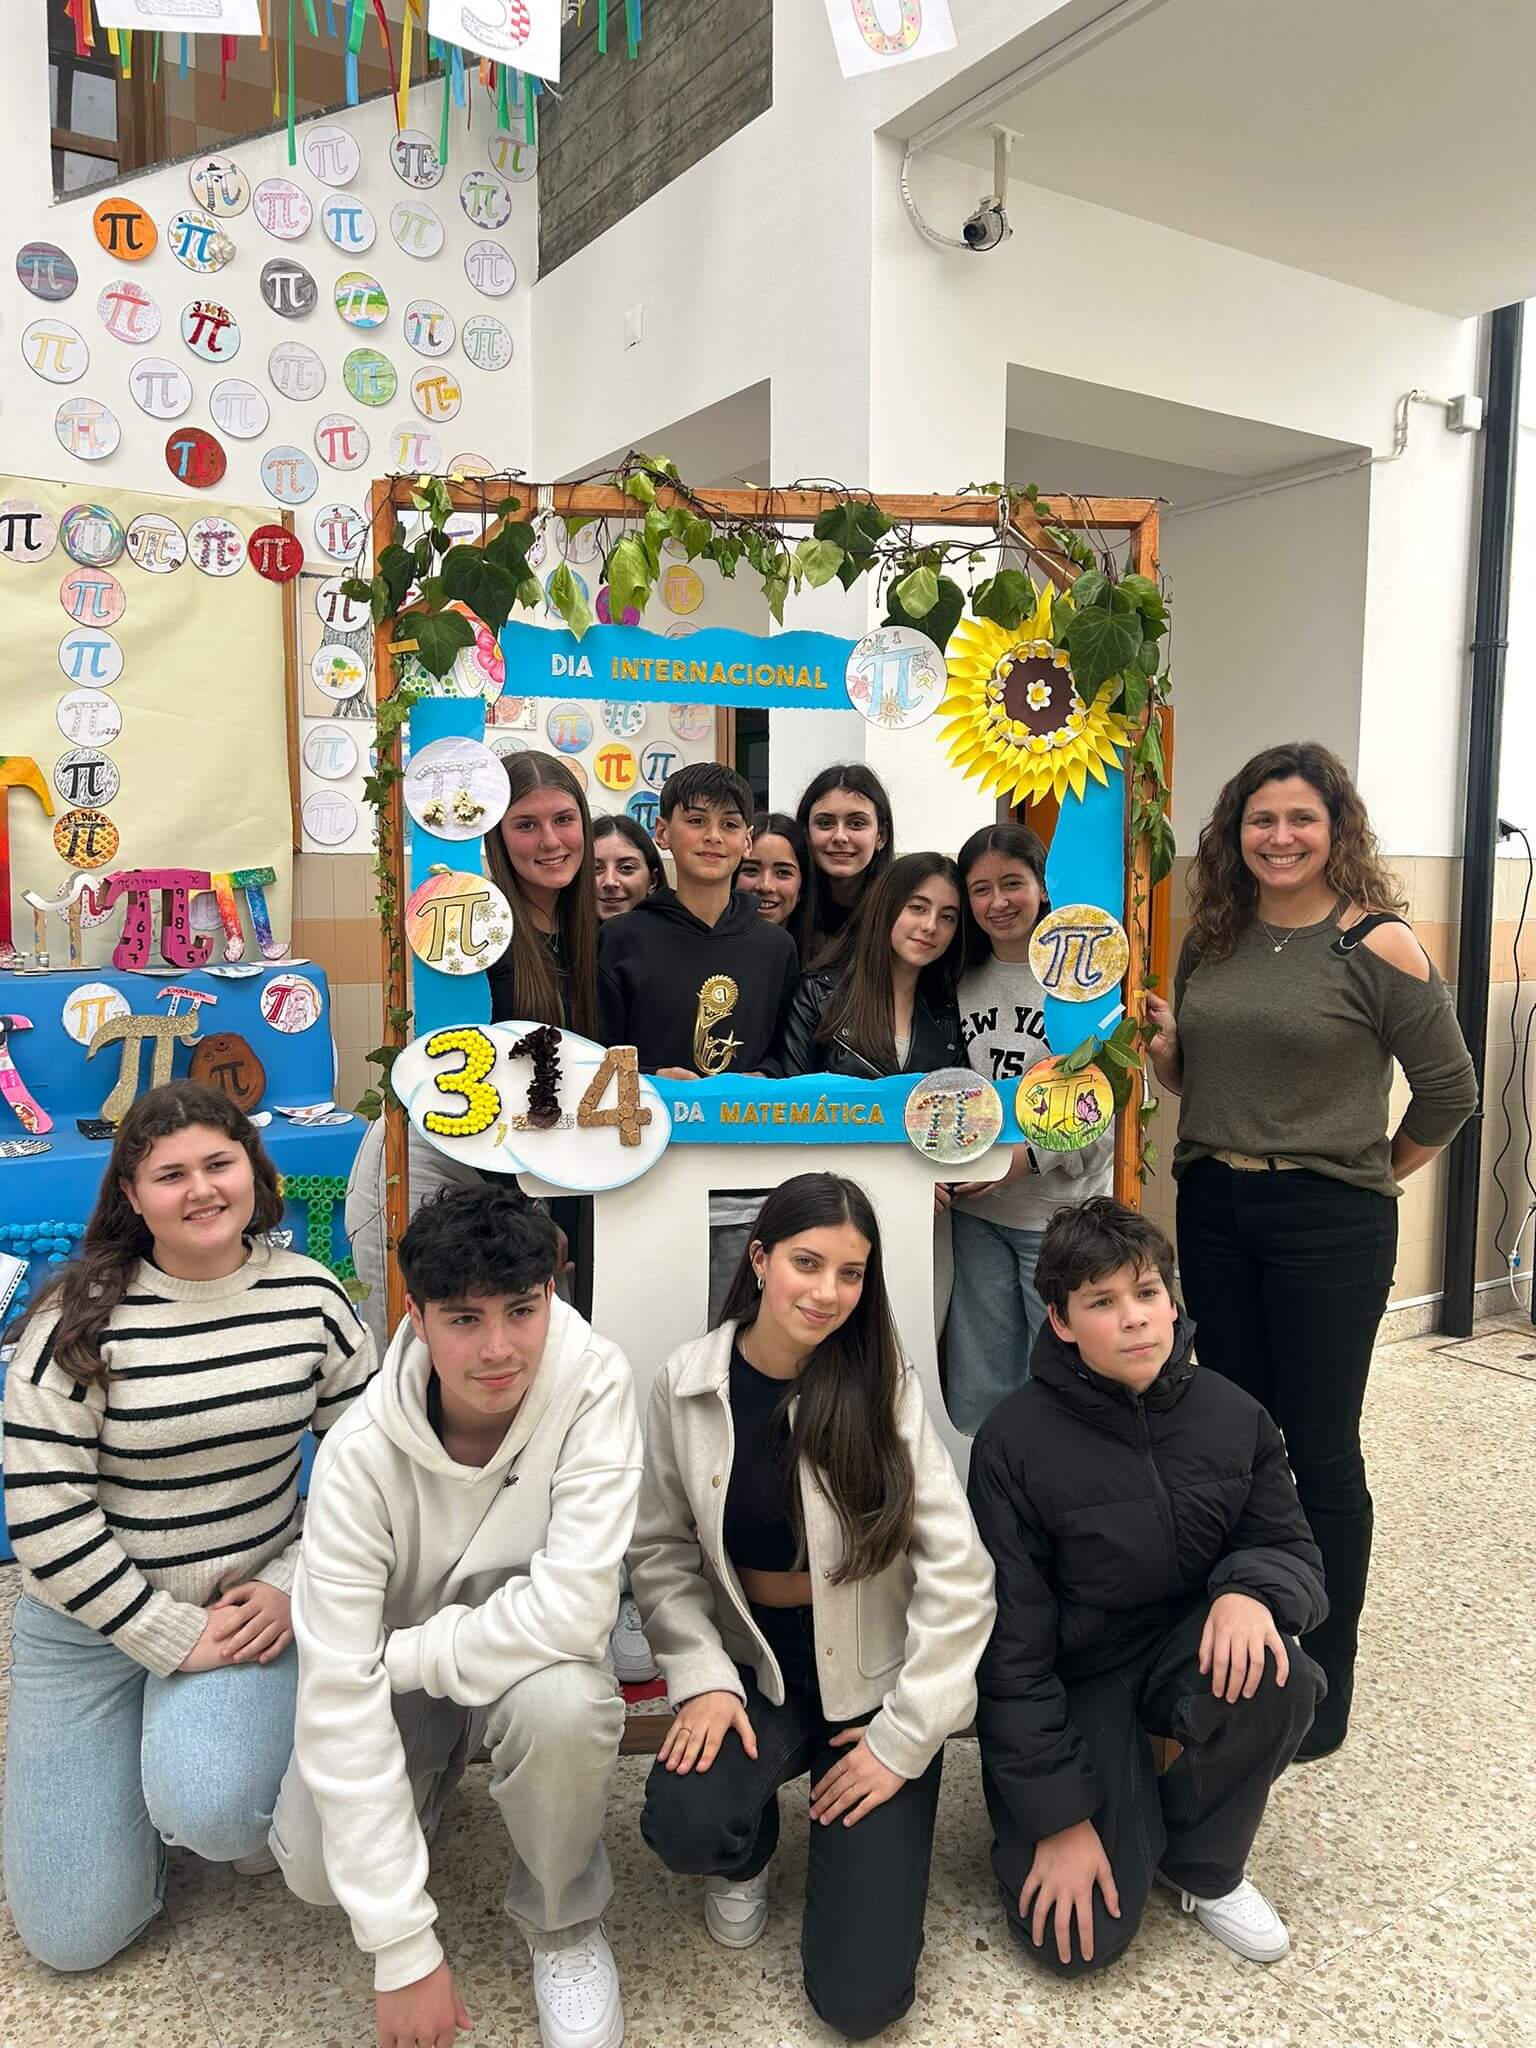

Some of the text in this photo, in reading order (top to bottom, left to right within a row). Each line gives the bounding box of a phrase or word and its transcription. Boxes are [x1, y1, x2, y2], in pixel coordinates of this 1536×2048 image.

[551, 653, 828, 690] DIA INTERNACIONAL
[960, 1006, 1051, 1049] EW YO
[990, 1047, 1025, 1081] 75
[674, 1094, 885, 1126] DA MATEMÁTICA
